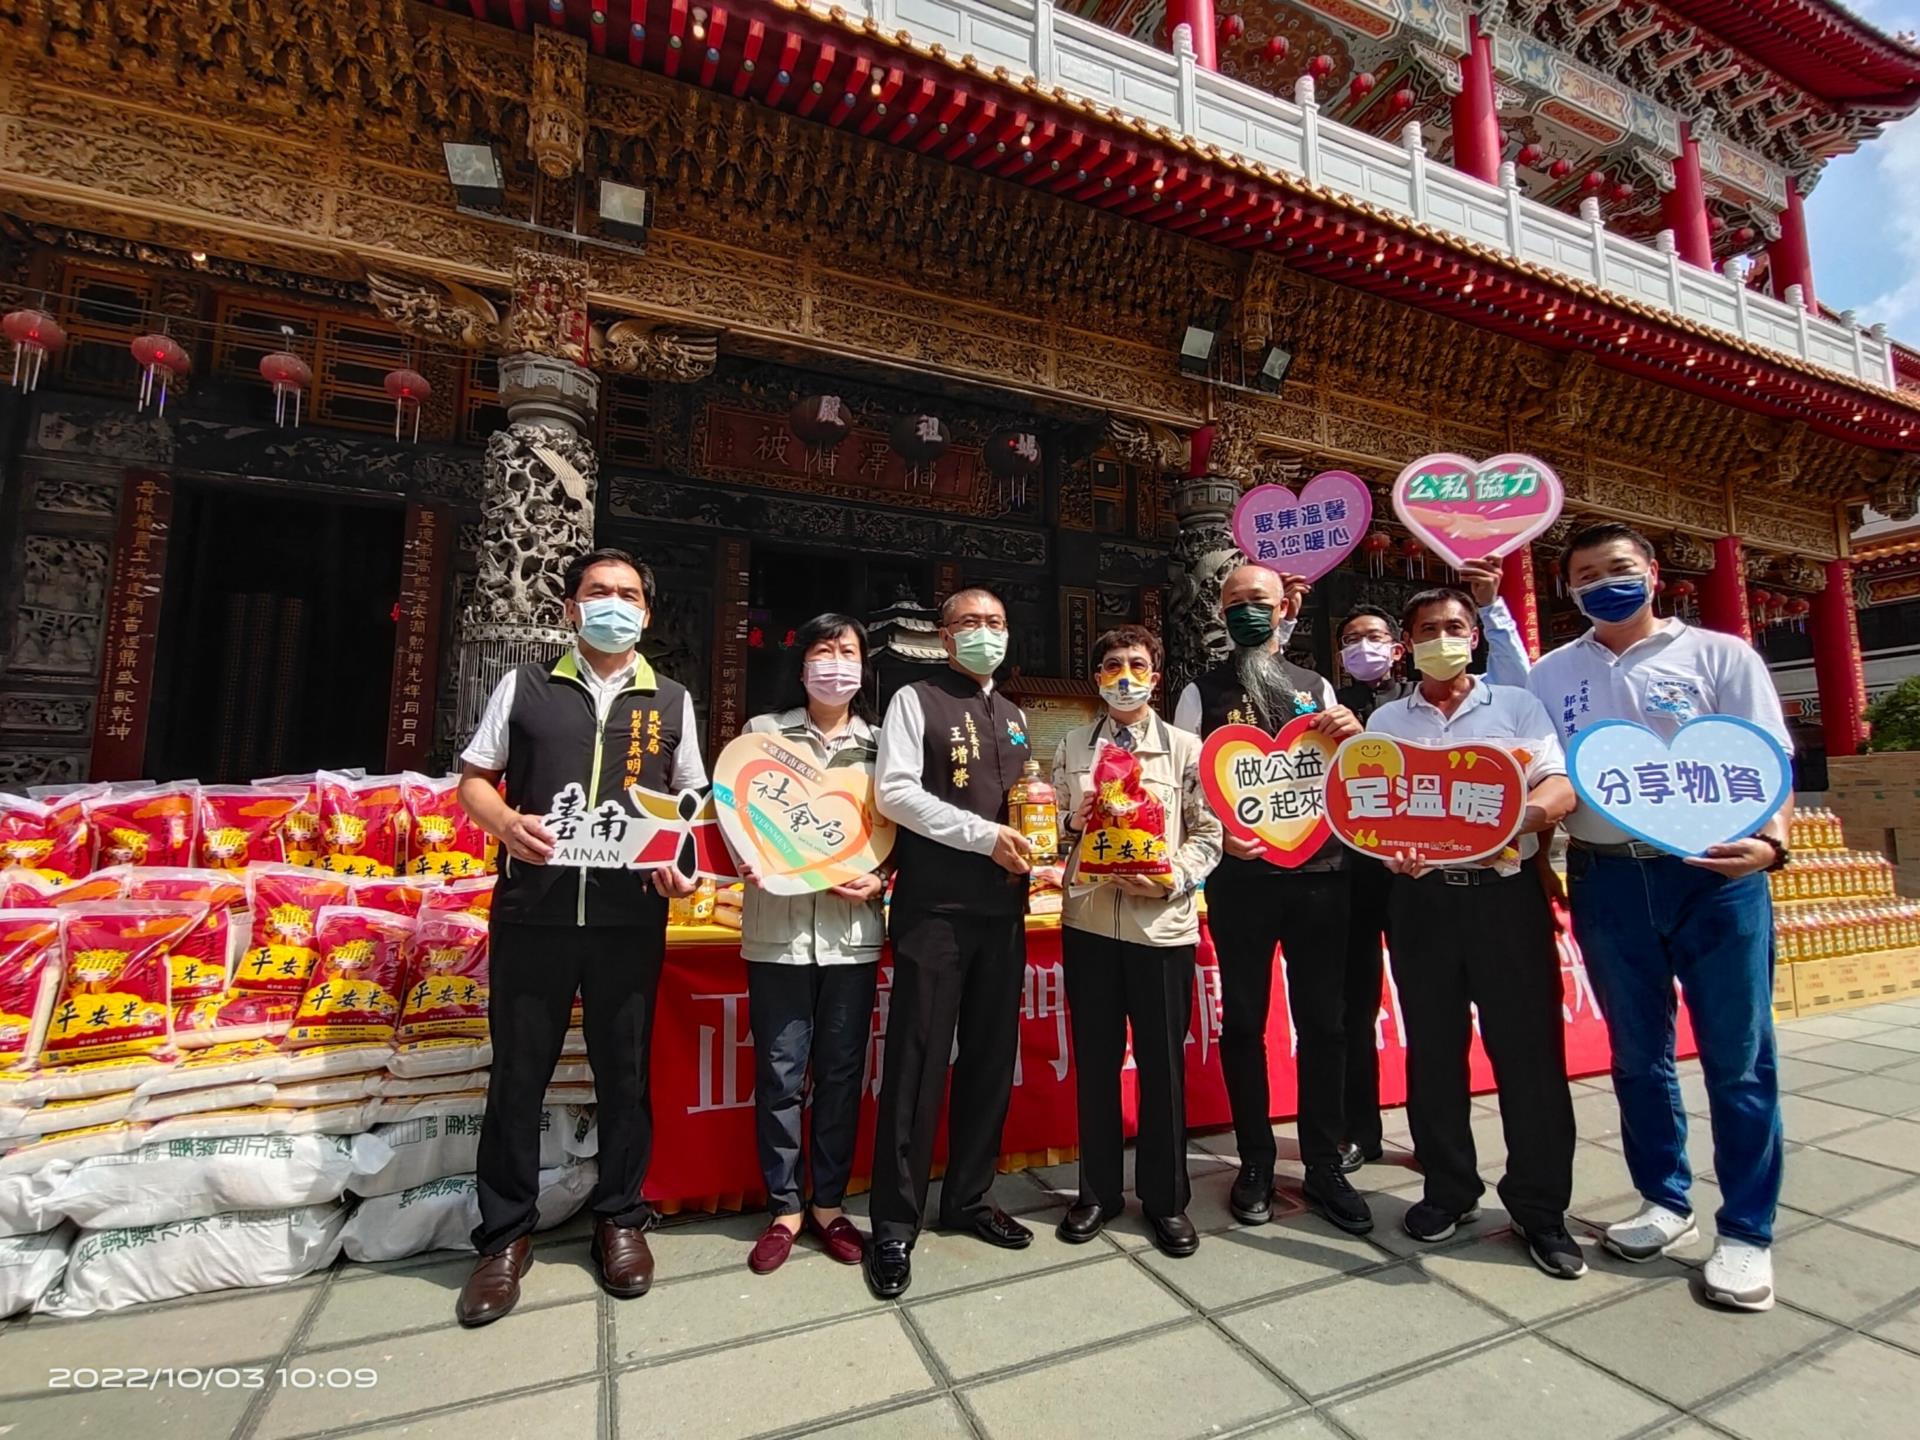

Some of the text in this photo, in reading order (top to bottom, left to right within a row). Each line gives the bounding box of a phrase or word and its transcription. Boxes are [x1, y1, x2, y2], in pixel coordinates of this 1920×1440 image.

[1408, 467, 1540, 500] 公私協力
[1254, 498, 1348, 534] 聚集溫馨
[1256, 526, 1351, 561] 為您暖心
[1234, 747, 1324, 790] 做公益
[1596, 760, 1767, 806] 分享物資
[544, 787, 628, 843] 臺南
[751, 771, 847, 847] 社會局
[1345, 774, 1505, 828] 足溫暖
[555, 846, 620, 863] AINAN
[1092, 830, 1158, 862] 平安米
[414, 852, 472, 876] 平安米
[311, 986, 384, 1011] 平安米
[411, 980, 478, 1009] 平安米
[56, 1000, 141, 1034] 平安米
